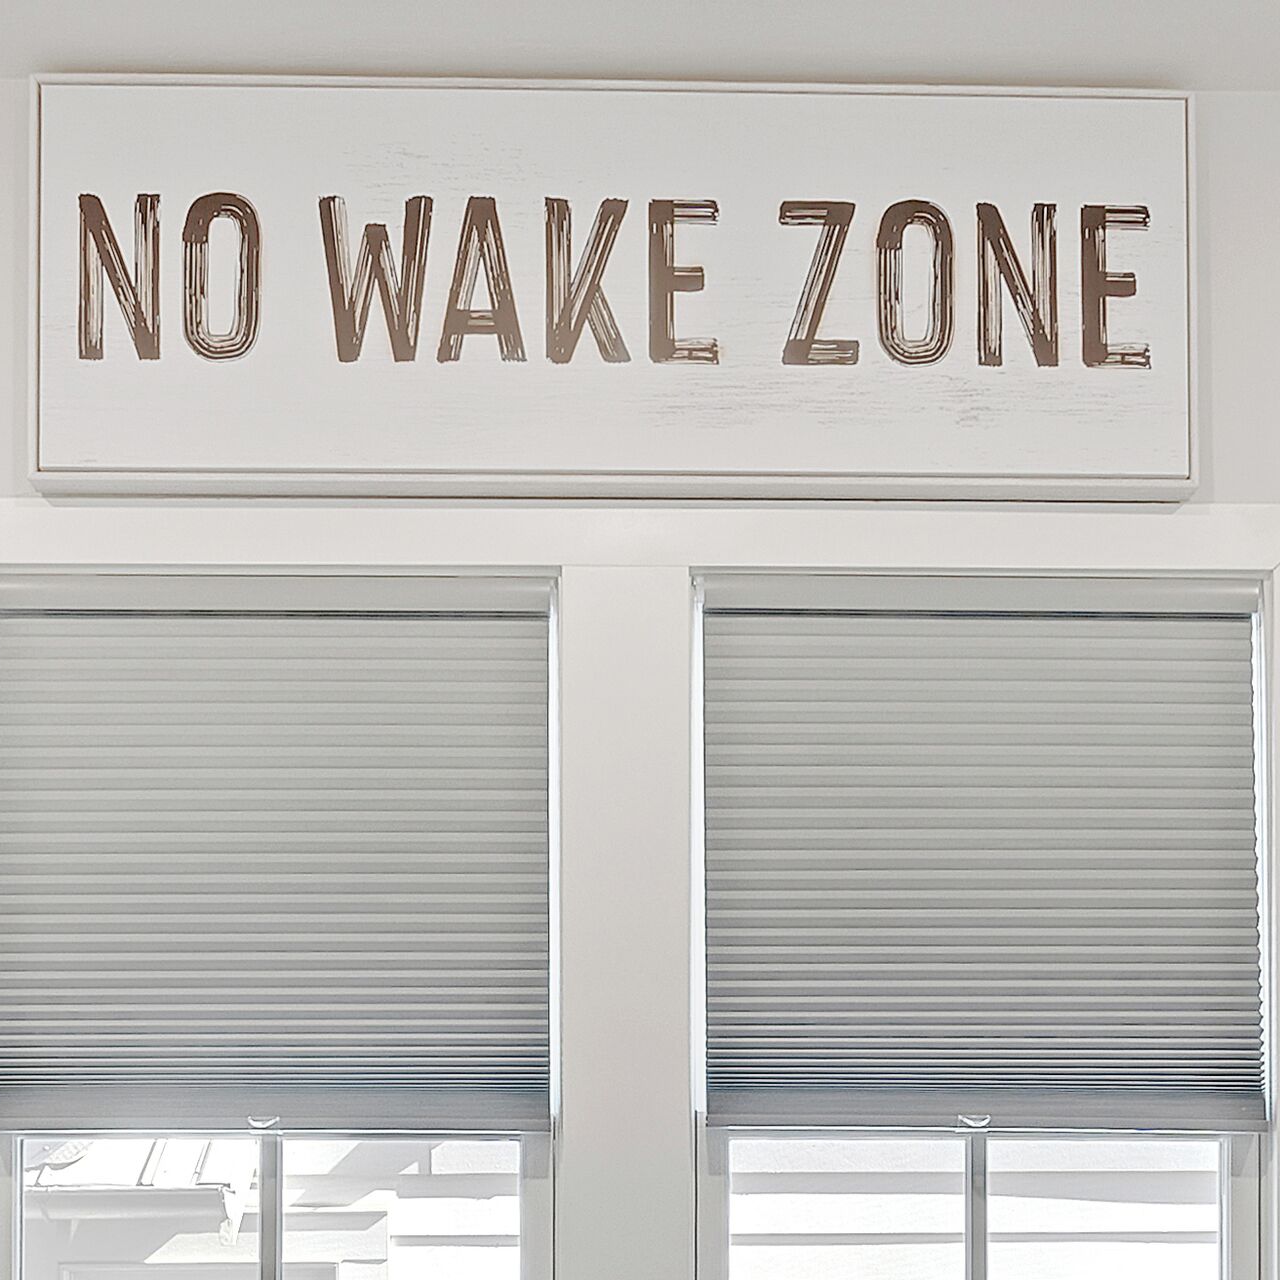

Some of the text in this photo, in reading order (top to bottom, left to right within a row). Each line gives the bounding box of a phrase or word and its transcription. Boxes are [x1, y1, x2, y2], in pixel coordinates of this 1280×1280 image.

[77, 192, 1153, 370] NO WAKE ZONE
